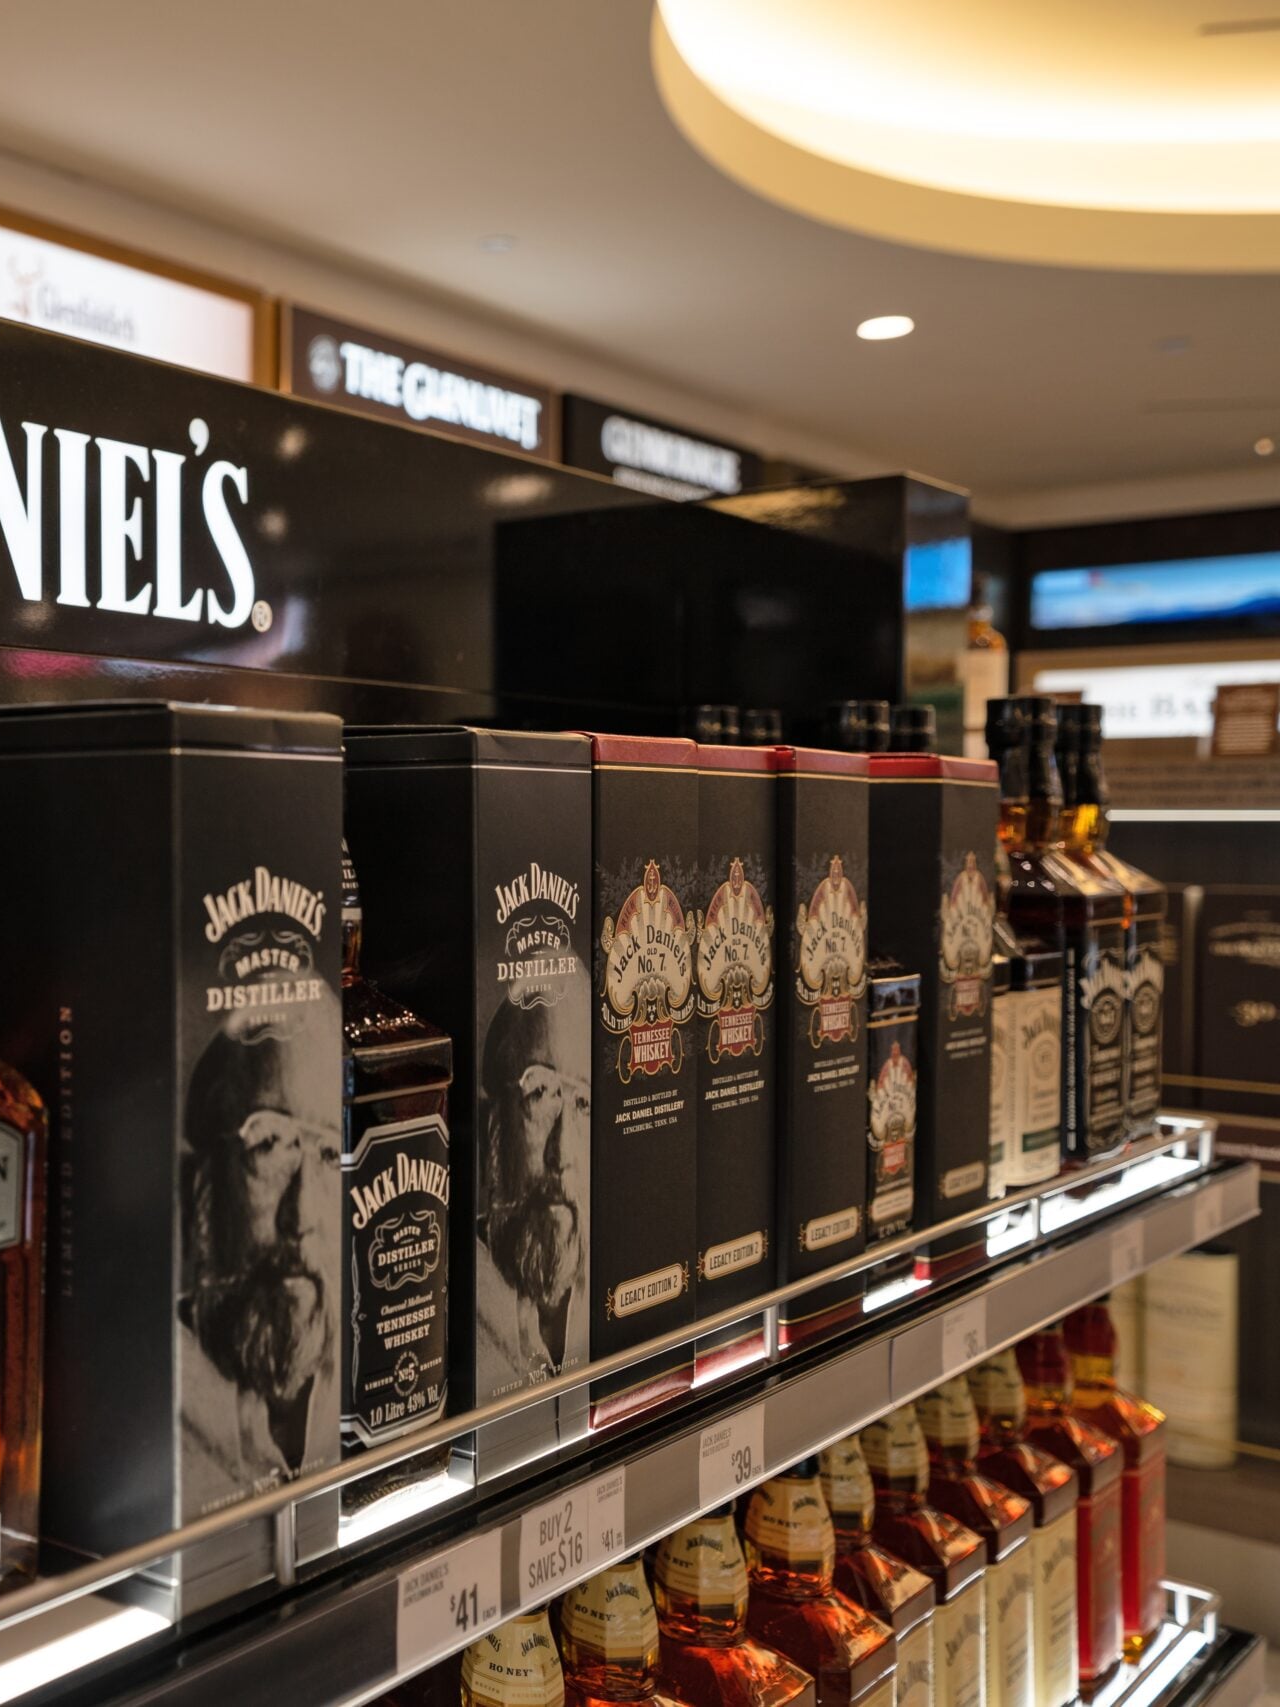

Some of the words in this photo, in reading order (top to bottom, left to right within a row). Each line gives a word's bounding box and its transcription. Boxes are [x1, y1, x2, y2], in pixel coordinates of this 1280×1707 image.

[340, 342, 405, 406] THE
[203, 878, 255, 943] JACK
[254, 866, 326, 937] DANIEL'S
[495, 873, 529, 924] JACK
[530, 862, 579, 920] DANIEL'S
[516, 930, 561, 955] MASTER
[613, 934, 641, 982] Jack
[646, 924, 688, 977] Daniel's
[646, 947, 658, 956] OLD
[703, 926, 727, 971] Jack
[731, 916, 767, 966] Daniel's
[724, 944, 740, 963] No.
[806, 921, 828, 961] Jack
[235, 948, 300, 979] MASTER
[497, 957, 577, 981] DISTILLER
[637, 954, 656, 974] No.
[206, 978, 321, 1012] DISTILLER
[616, 1013, 633, 1030] TIME
[721, 1012, 753, 1029] TENNESSEE
[633, 1027, 670, 1044] TENNESSEE
[721, 1026, 753, 1046] WHISKEY
[633, 1040, 670, 1064] WHISKEY
[705, 1089, 719, 1101] JACK
[720, 1086, 738, 1098] DANIEL
[738, 1080, 765, 1095] DISTILLERY
[615, 1110, 631, 1124] JACK
[631, 1106, 653, 1121] DANIEL
[653, 1099, 685, 1115] DISTILLERY
[350, 1167, 397, 1229] JACK
[396, 1152, 450, 1206] DANIEL'S
[392, 1226, 422, 1243] MASTER
[378, 1239, 435, 1267] DISTILLER
[393, 1259, 422, 1274] SERIES
[710, 1251, 731, 1270] LEGACY
[733, 1243, 754, 1262] EDITION
[754, 1241, 759, 1254] 2
[620, 1286, 646, 1308] LEGACY
[647, 1276, 672, 1298] EDITION
[673, 1274, 678, 1289] 2
[376, 1305, 436, 1336] TENNESSEE
[384, 1324, 430, 1351] WHISKEY
[364, 1376, 394, 1391] LIMITED
[419, 1356, 442, 1371] EDITION
[492, 1380, 523, 1397] LIMITED
[370, 1405, 383, 1427] 1.0
[385, 1401, 405, 1422] Litre
[407, 1390, 426, 1413] 43%
[731, 1446, 751, 1484] $39
[539, 1512, 562, 1546] BUY
[564, 1500, 573, 1534] 2
[601, 1528, 614, 1552] $41
[528, 1551, 557, 1588] SAVE
[558, 1532, 583, 1576] $16
[420, 1561, 449, 1587] DANIEL'S
[449, 1583, 478, 1632] $41
[483, 1605, 497, 1621] EACH
[521, 1638, 535, 1657] JACK
